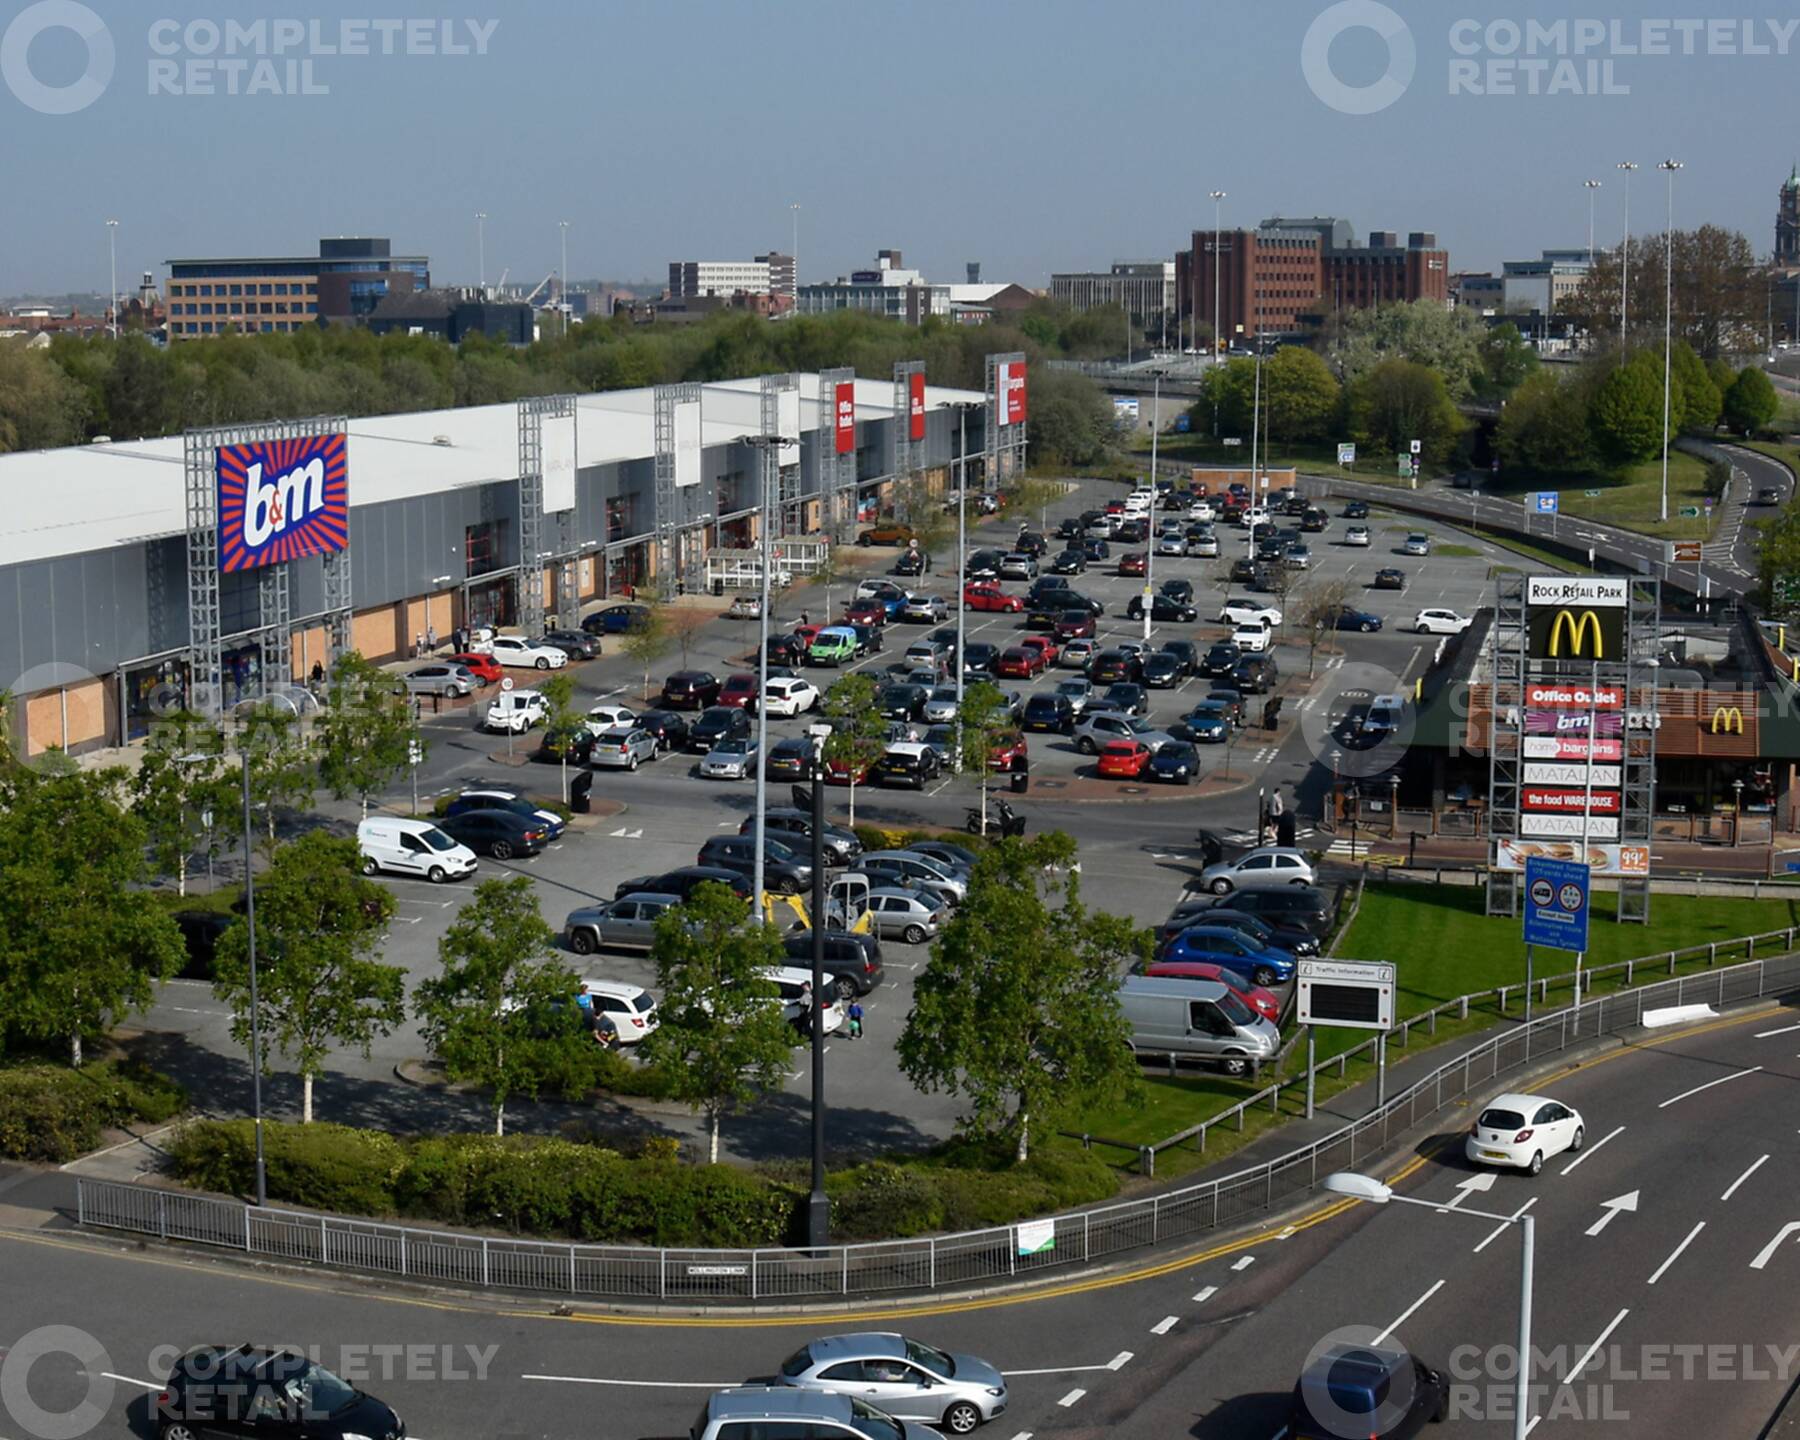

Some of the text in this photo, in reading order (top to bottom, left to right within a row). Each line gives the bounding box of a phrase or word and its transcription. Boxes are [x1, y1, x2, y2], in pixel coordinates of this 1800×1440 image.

[244, 457, 324, 547] b&m
[1532, 690, 1572, 702] Office
[1563, 743, 1614, 755] bargins
[1527, 767, 1617, 782] MATALAN
[1528, 794, 1613, 807] the food WAREOUSE
[1524, 818, 1614, 833] MATALAN
